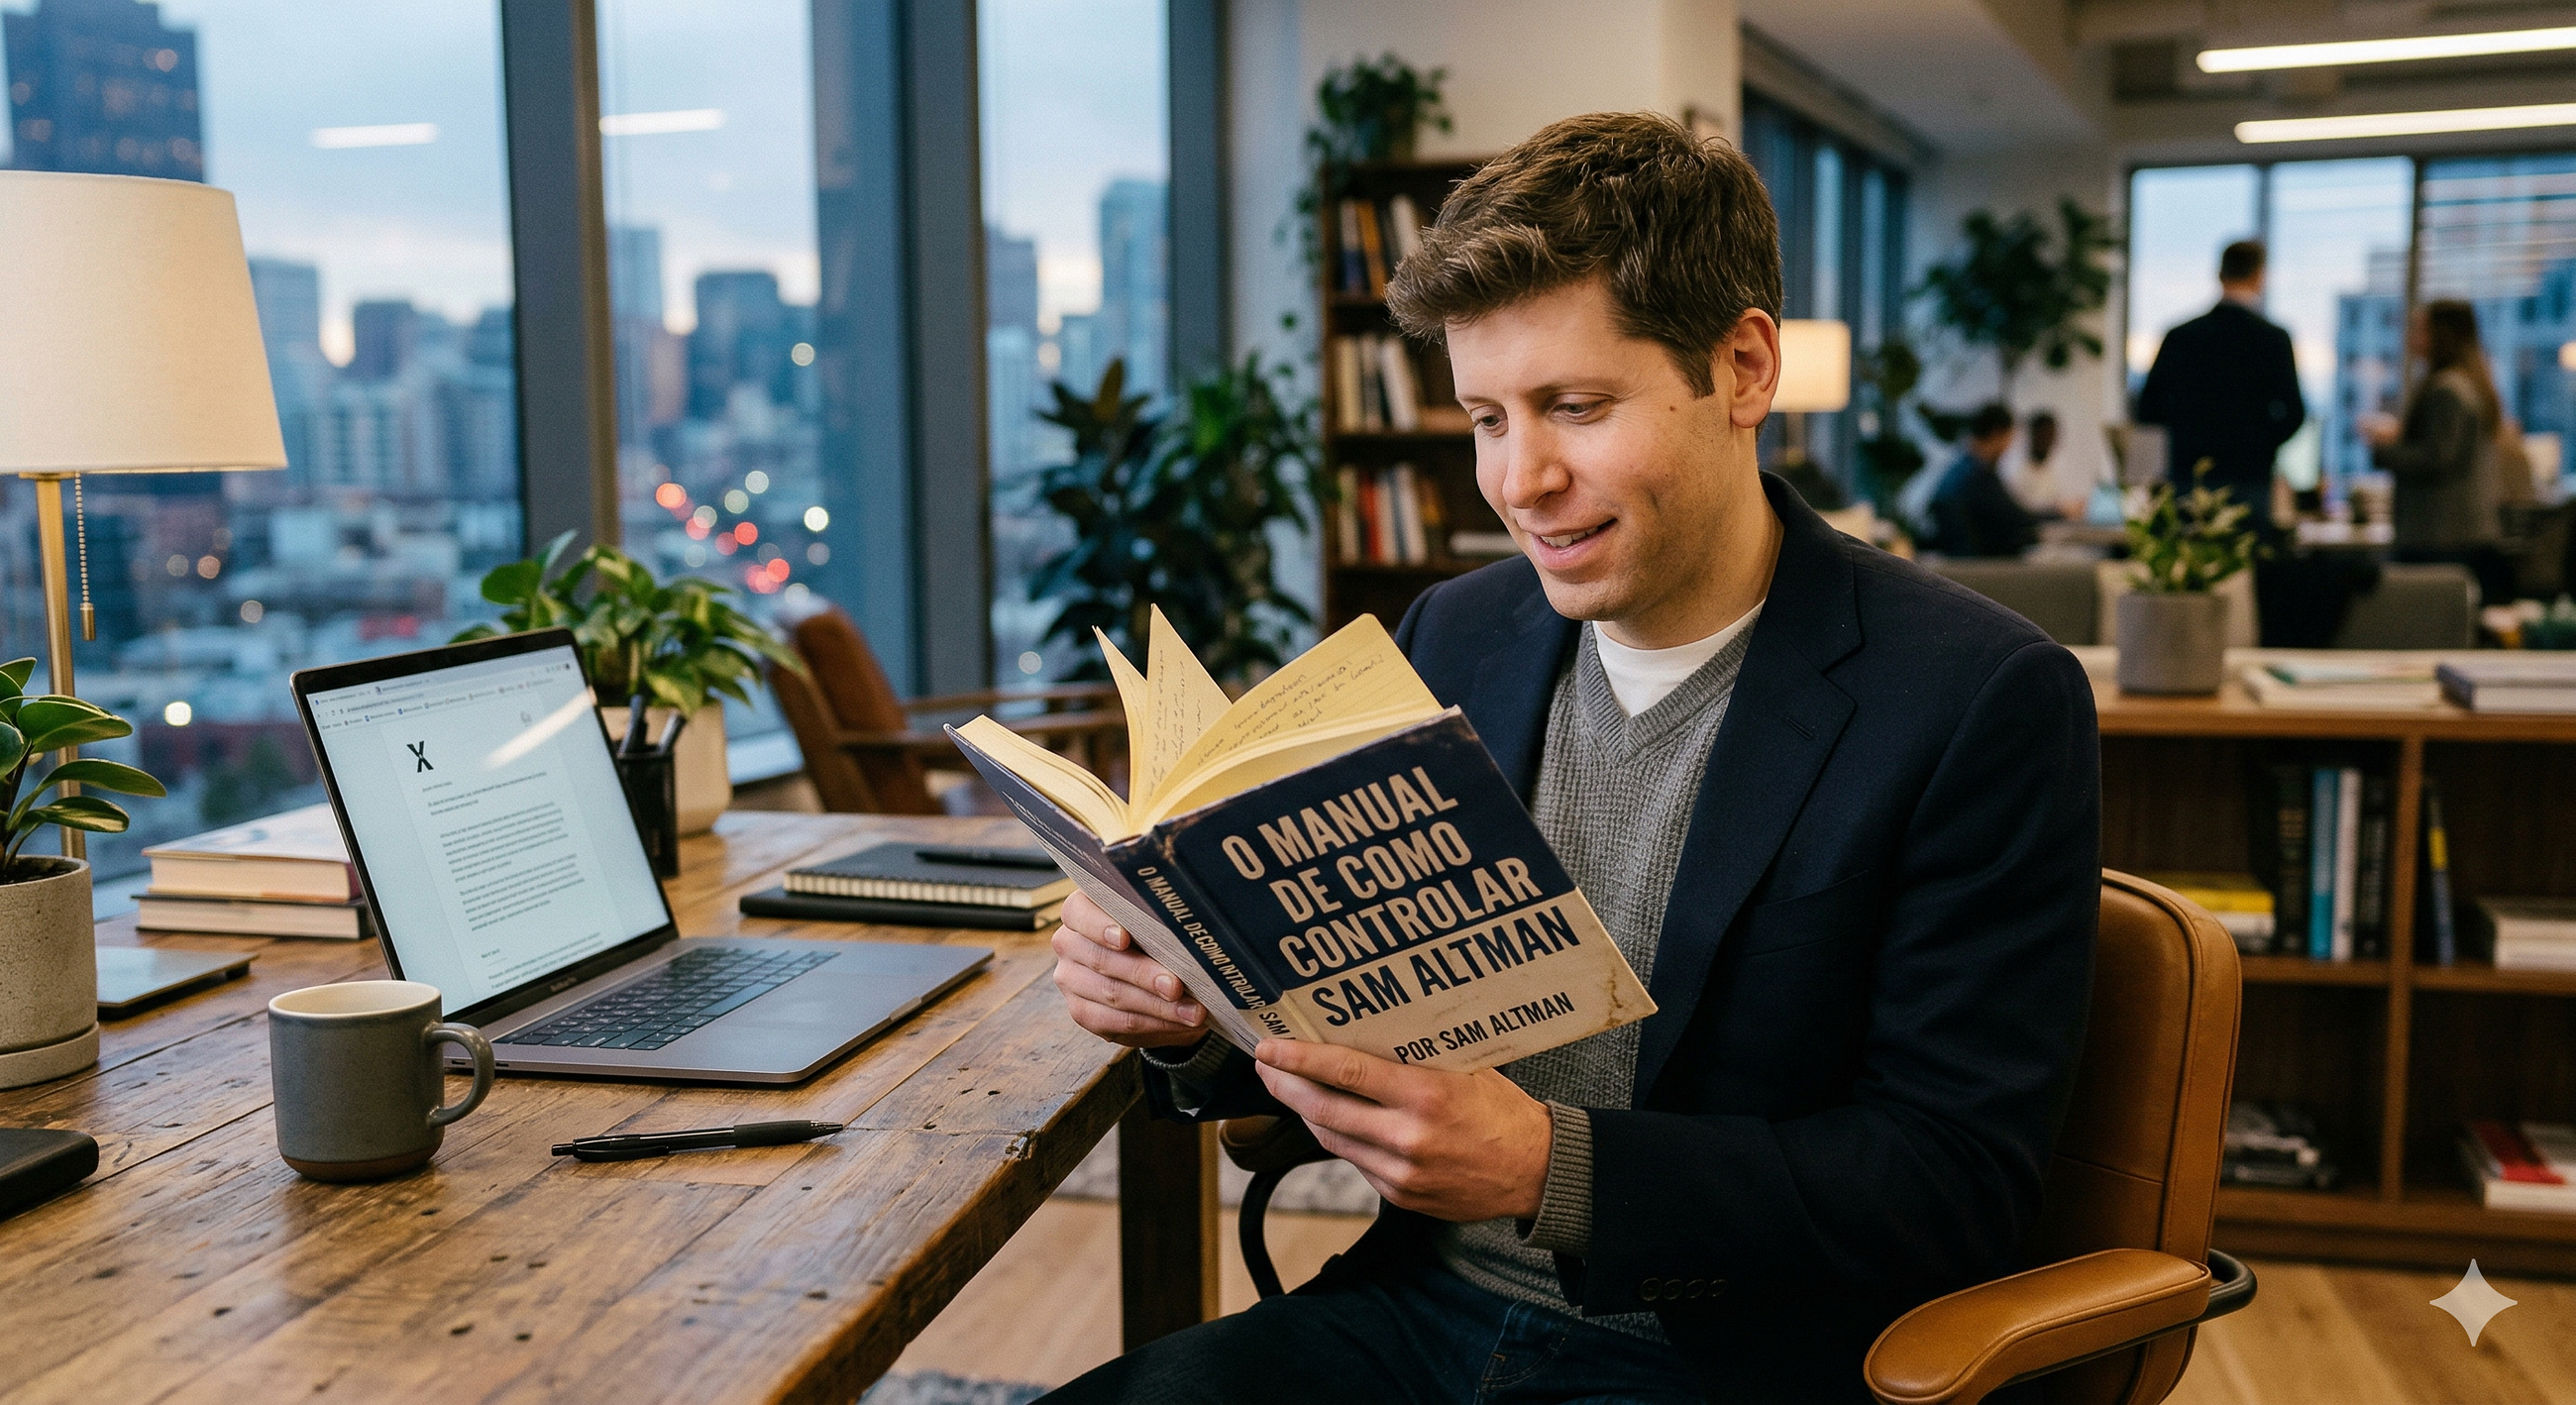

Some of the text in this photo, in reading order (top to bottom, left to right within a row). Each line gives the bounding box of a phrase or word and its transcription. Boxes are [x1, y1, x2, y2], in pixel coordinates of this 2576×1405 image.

[406, 740, 434, 773] X
[1222, 766, 1459, 880] O MANUAL
[1137, 866, 1157, 877] O
[1144, 876, 1193, 922] MANUAL
[1268, 820, 1472, 923] DE COMO
[1279, 857, 1543, 978] CONTROLAR
[1312, 906, 1580, 1027] SAM ALTMAN
[1259, 1012, 1290, 1035] SAM
[1393, 992, 1575, 1064] POR SAM ALTMAN
